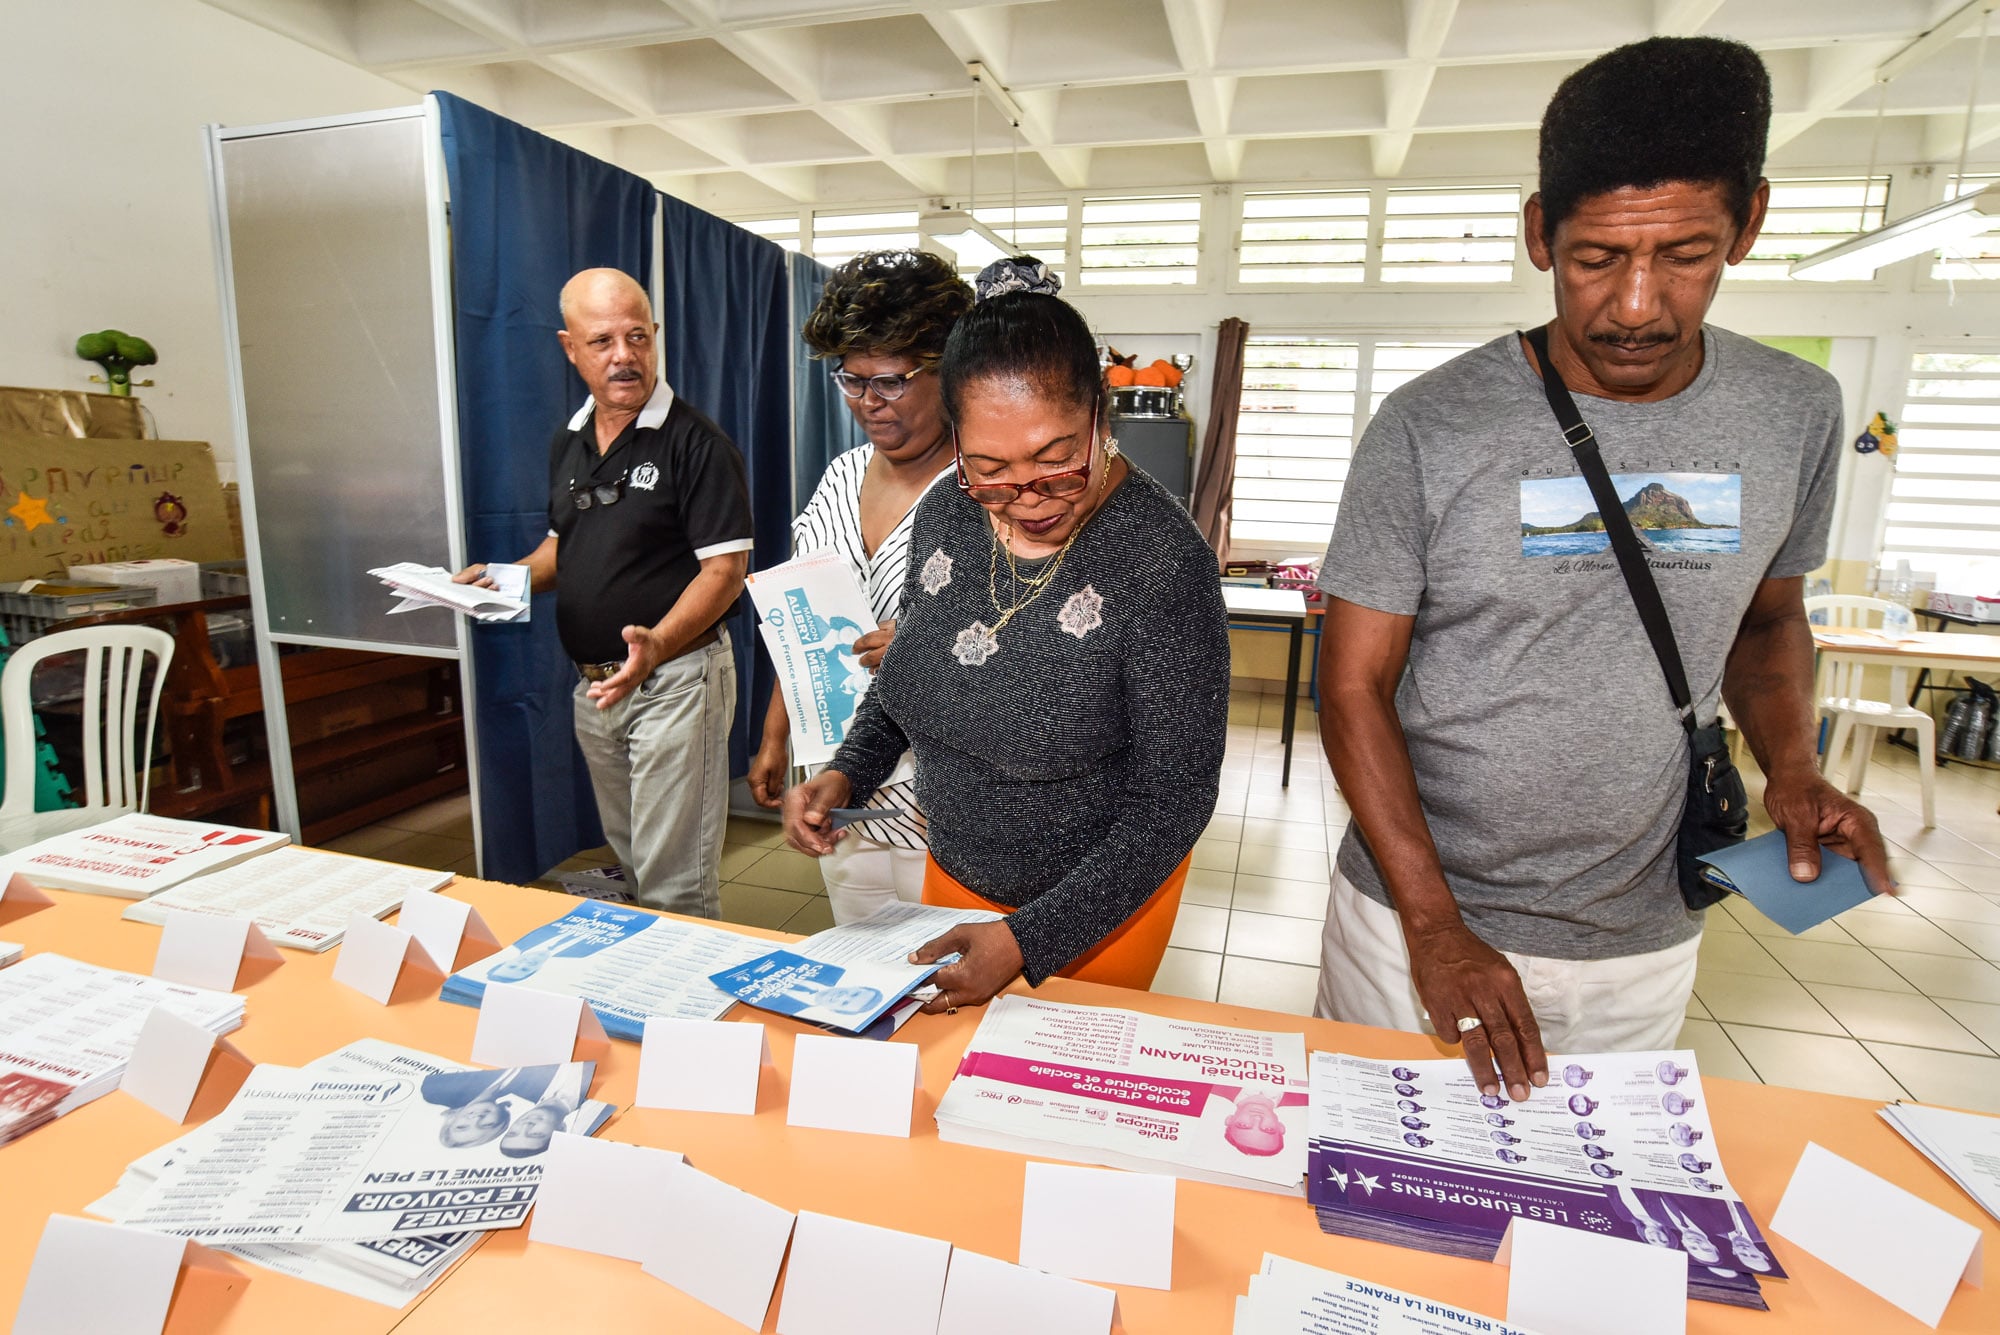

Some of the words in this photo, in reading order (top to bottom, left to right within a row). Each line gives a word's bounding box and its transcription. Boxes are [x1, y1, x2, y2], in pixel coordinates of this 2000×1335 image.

[1521, 462, 1740, 476] QUISILVER
[1553, 560, 1571, 574] Le
[1646, 558, 1712, 571] auritius
[786, 594, 812, 642] AUBRY
[802, 606, 819, 641] MANON
[818, 650, 833, 693] JEAN-LUC
[783, 644, 796, 679] France
[791, 681, 807, 734] insoumise
[807, 652, 835, 743] MÉLENCHON
[1034, 1031, 1074, 1041] GERMAIN
[1071, 1047, 1117, 1059] Christophe
[1181, 1042, 1232, 1053] GUILLAUME
[0, 1053, 39, 1069] HAMO
[1052, 1050, 1093, 1062] MEBAREK
[1095, 1057, 1116, 1065] Nora
[1139, 1046, 1285, 1073] GLUCKSMANN
[1029, 1065, 1081, 1081] sociale
[1085, 1075, 1100, 1084] et
[1201, 1066, 1285, 1085] Raphaël
[310, 1082, 383, 1092] National
[1072, 1082, 1143, 1100] d'Europe
[1104, 1079, 1191, 1098] écologique
[243, 1088, 376, 1102] Rassemblement
[980, 1091, 1003, 1101] PRG
[1146, 1093, 1190, 1106] envie
[1115, 1117, 1179, 1134] d'Europe
[1138, 1129, 1178, 1141] envie
[363, 1171, 415, 1184] PEN
[417, 1169, 449, 1182] LE
[451, 1164, 544, 1179] MARINE
[1390, 1172, 1430, 1184] L'EUROPE
[1432, 1179, 1475, 1192] RELANCER
[1477, 1187, 1500, 1197] POUR
[355, 1187, 495, 1210] POUVOIR,
[497, 1186, 533, 1203] LE
[1390, 1181, 1522, 1215] EUROPÉENS
[1502, 1191, 1564, 1207] L'ALTERNATIVE
[401, 1204, 524, 1229] PRENEZ
[1527, 1205, 1569, 1223] LES
[1587, 1216, 1605, 1225] udi
[222, 1225, 285, 1237] Jordan
[1345, 1281, 1401, 1305] FRANCE
[1311, 1296, 1337, 1308] Roussel
[1347, 1297, 1370, 1309] Michel
[1403, 1296, 1422, 1311] LA
[1338, 1304, 1368, 1317] Nathalie
[1425, 1302, 1492, 1331] RÉTABLIR
[1348, 1315, 1369, 1326] Pierre
[1342, 1322, 1367, 1334] Valérie
